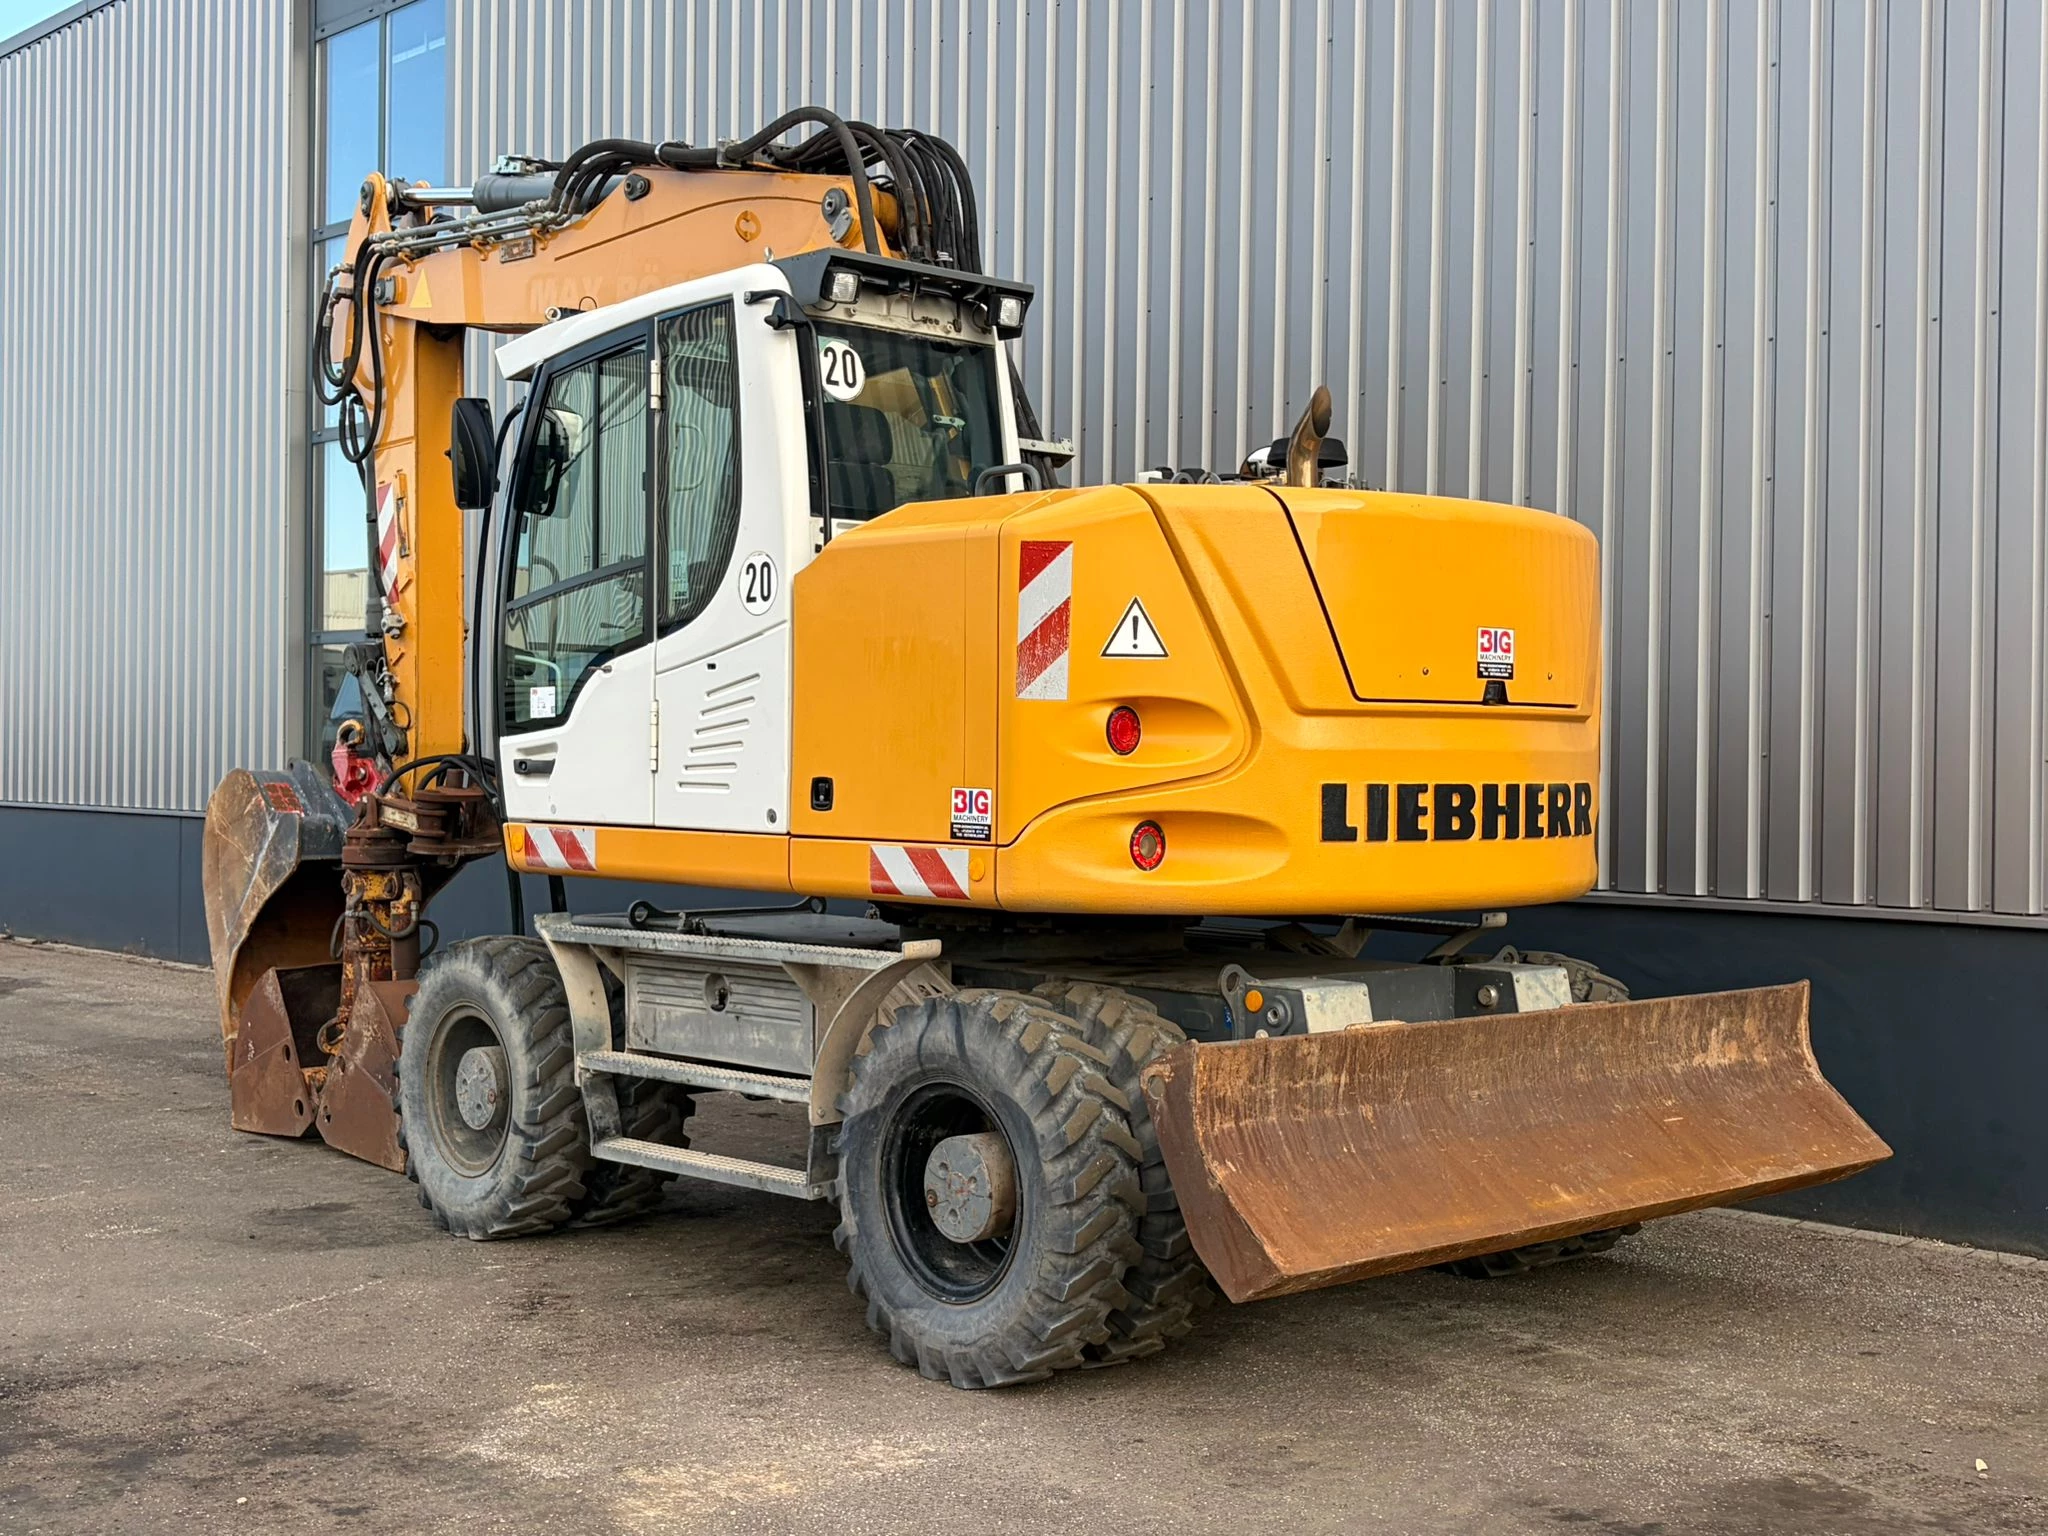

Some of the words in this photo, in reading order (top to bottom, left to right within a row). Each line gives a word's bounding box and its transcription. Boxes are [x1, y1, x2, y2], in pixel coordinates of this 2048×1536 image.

[824, 346, 857, 388] 20
[746, 561, 771, 603] 20
[1479, 654, 1511, 662] MACHINERY
[953, 813, 989, 823] MACHINERY
[1321, 782, 1593, 842] LIEBHERR
